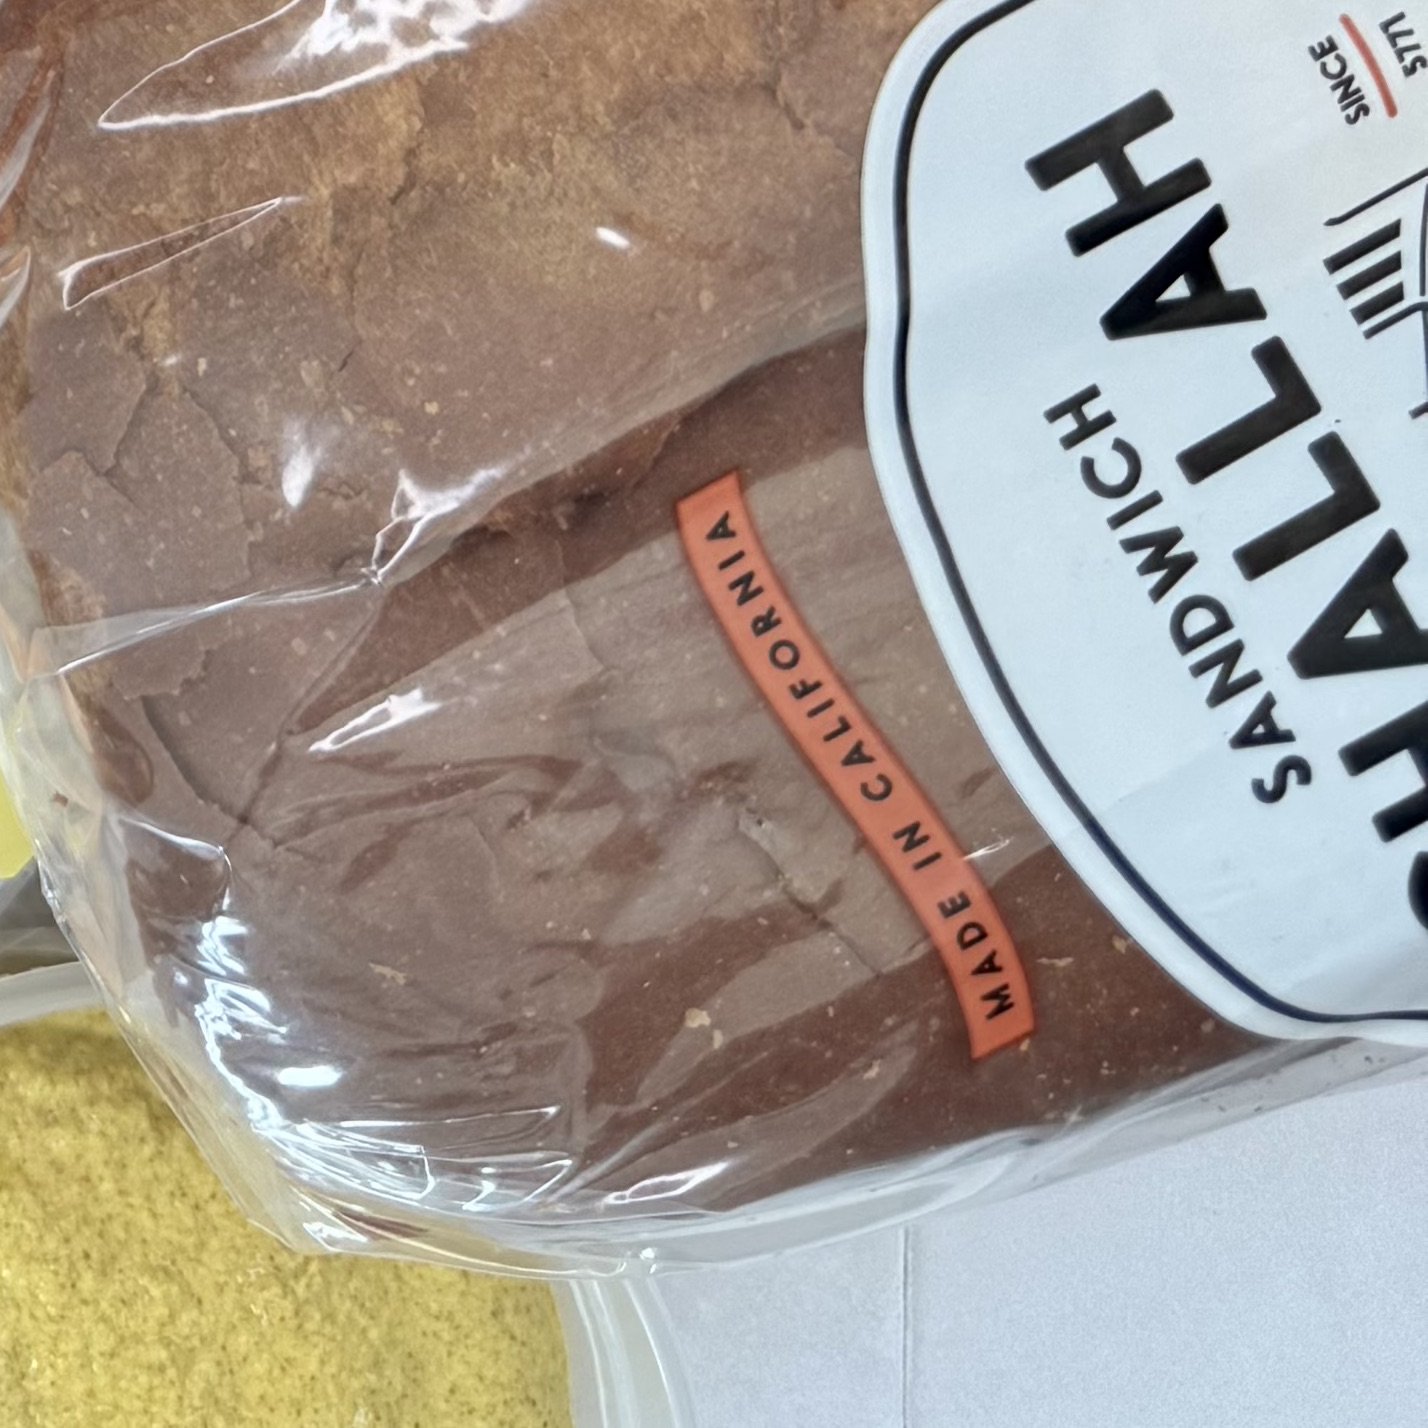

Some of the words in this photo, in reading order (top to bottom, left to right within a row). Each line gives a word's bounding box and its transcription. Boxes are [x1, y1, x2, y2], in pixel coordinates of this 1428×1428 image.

[1308, 35, 1370, 125] SINCE
[1379, 11, 1428, 78] 5771
[1043, 383, 1312, 805] SANDWICH
[705, 510, 893, 802] CALIFORNIA
[892, 819, 942, 872] IN
[937, 889, 1015, 1021] MADE
